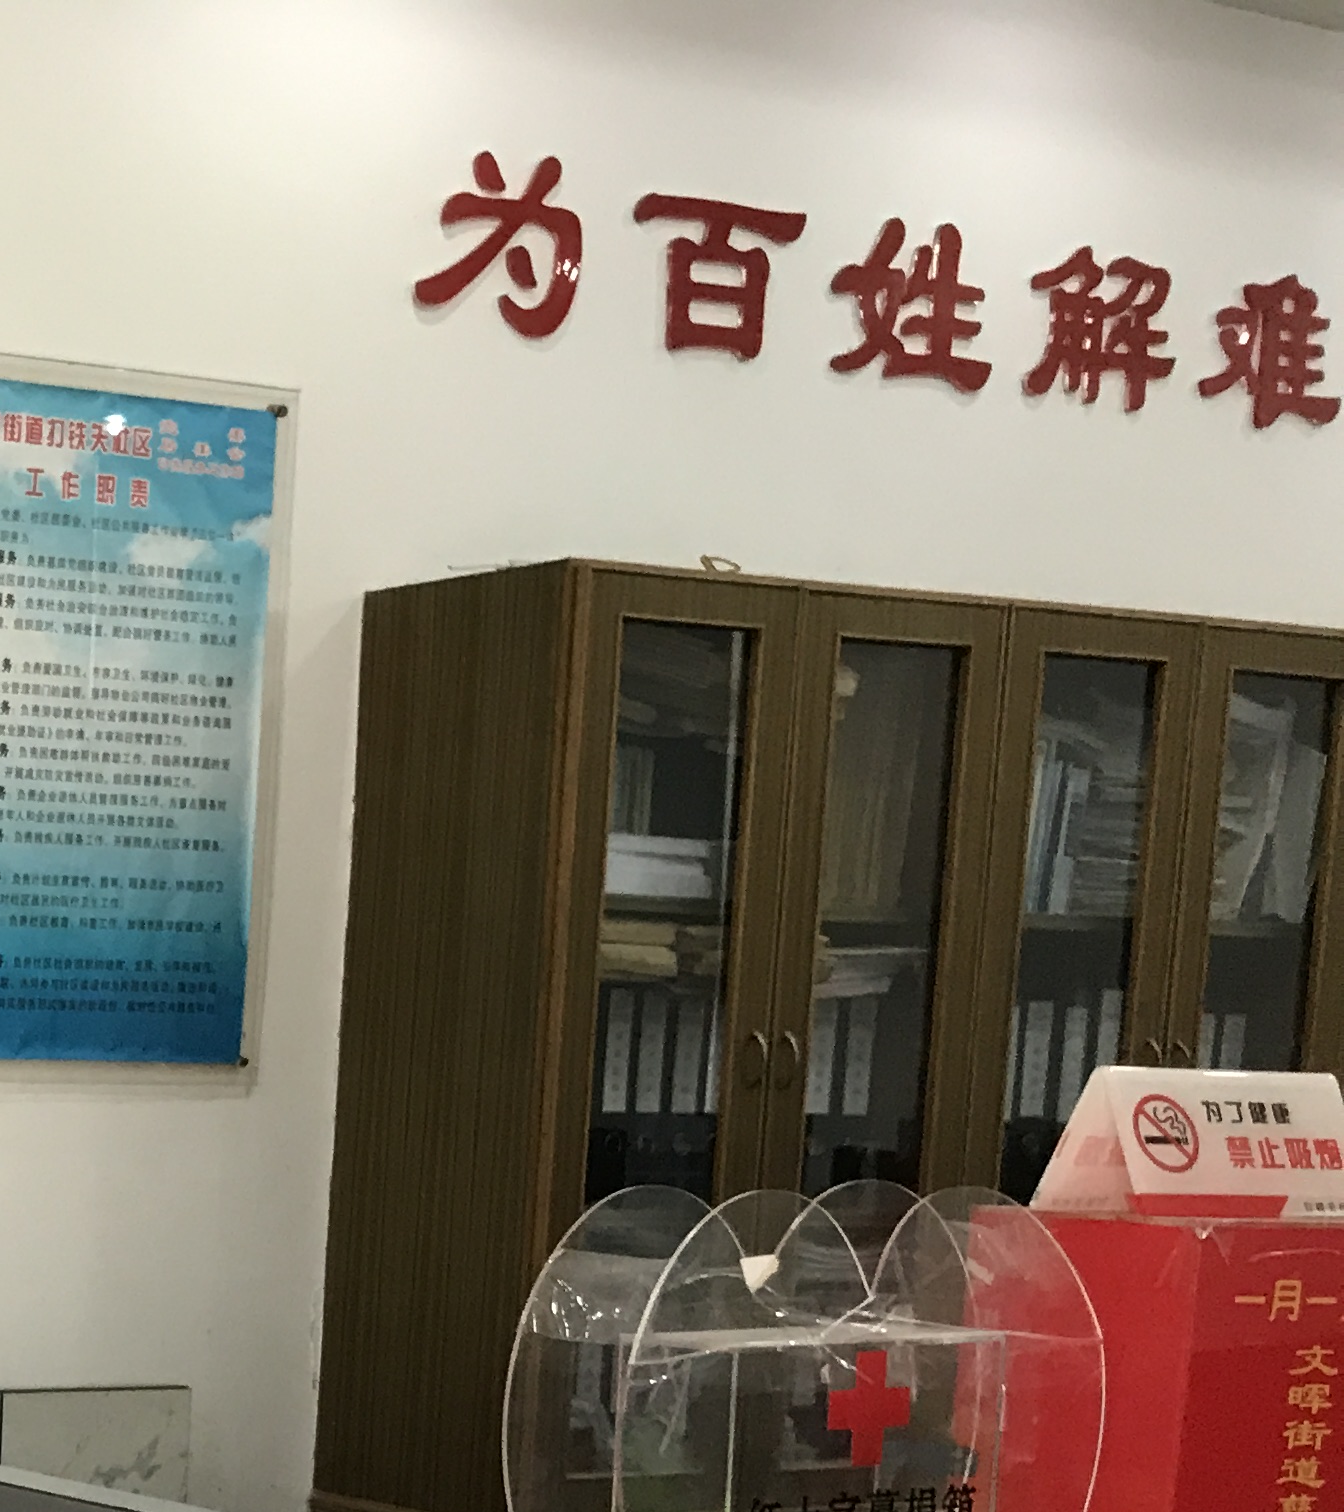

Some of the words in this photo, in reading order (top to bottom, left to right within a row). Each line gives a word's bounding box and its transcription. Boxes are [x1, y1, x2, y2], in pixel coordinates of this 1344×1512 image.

[412, 151, 1342, 431] 为百姓解难
[25, 468, 151, 508] 工作职责
[1225, 1136, 1344, 1170] 禁止吸烟
[1235, 1279, 1344, 1321] 一月一
